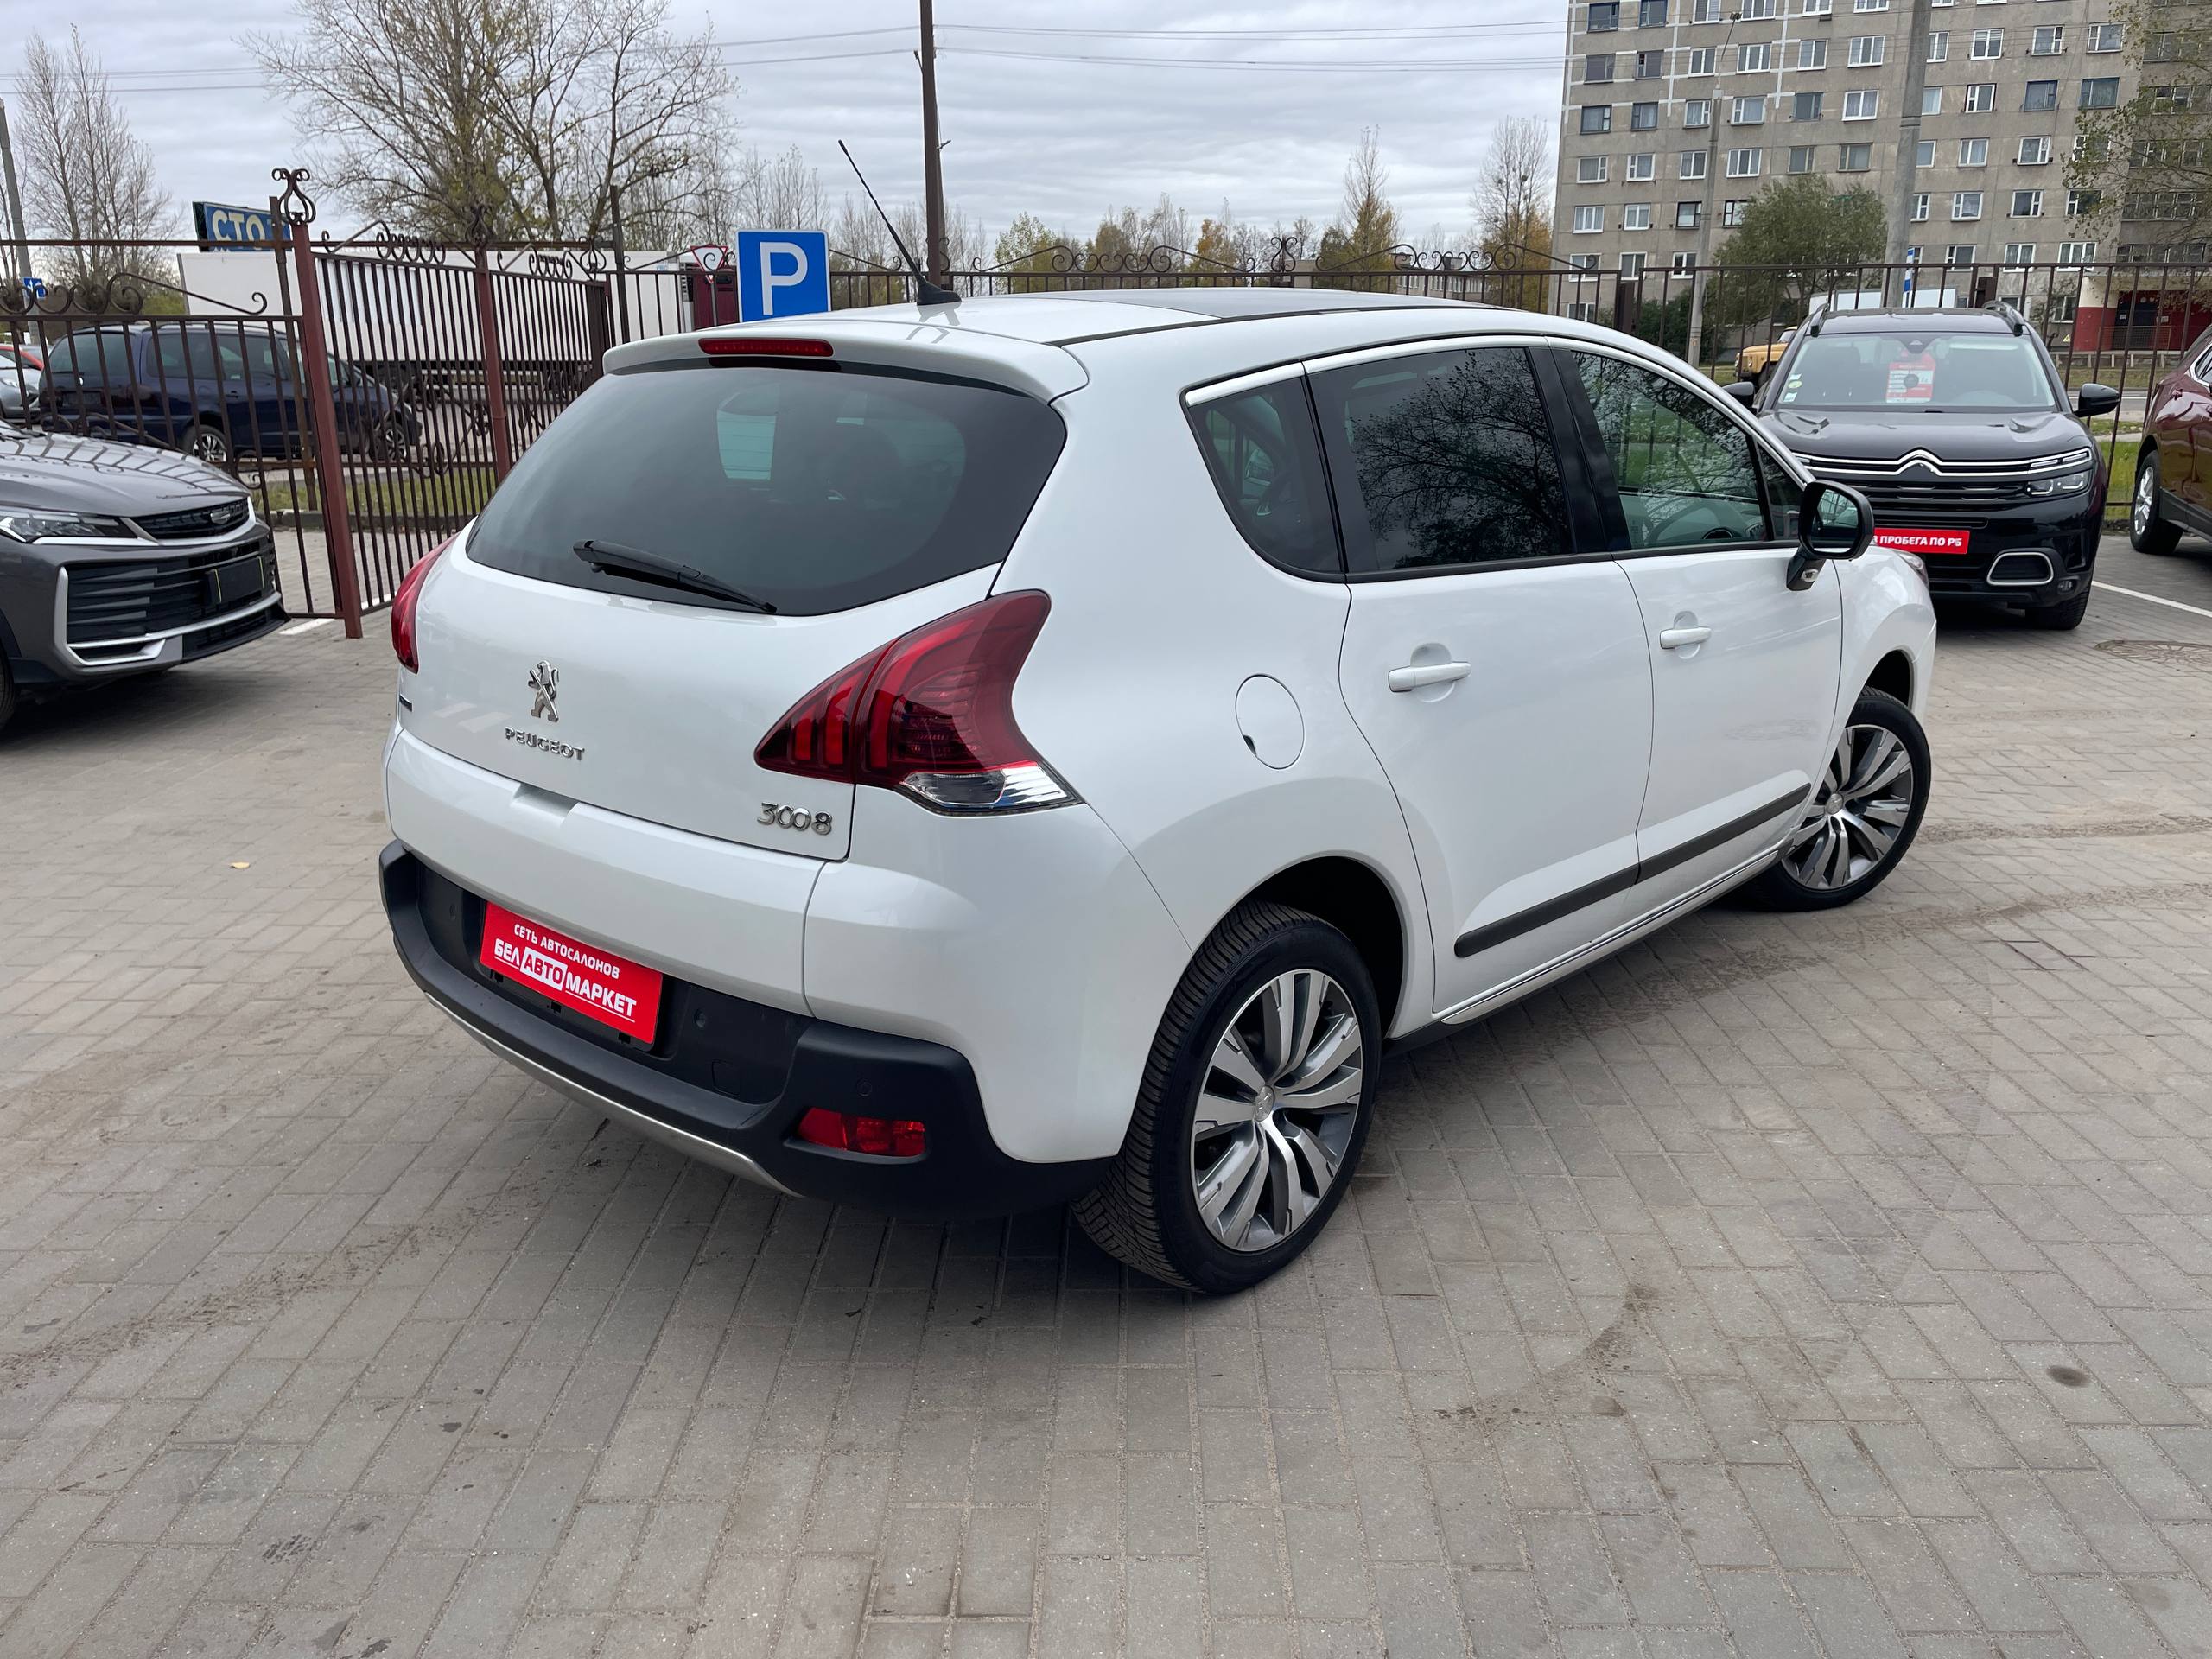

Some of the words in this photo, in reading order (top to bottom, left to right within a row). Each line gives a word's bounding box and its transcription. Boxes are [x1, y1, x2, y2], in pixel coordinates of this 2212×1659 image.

[760, 241, 808, 315] P
[1879, 535, 1928, 546] ПРОБЕГА
[1929, 537, 1946, 546] ПО
[1947, 537, 1962, 547] РБ
[505, 726, 585, 761] PEUGEOT
[757, 801, 833, 836] 3008
[514, 924, 538, 944] СЕТЬ
[540, 936, 620, 980] АВТОСАЛОНОВ
